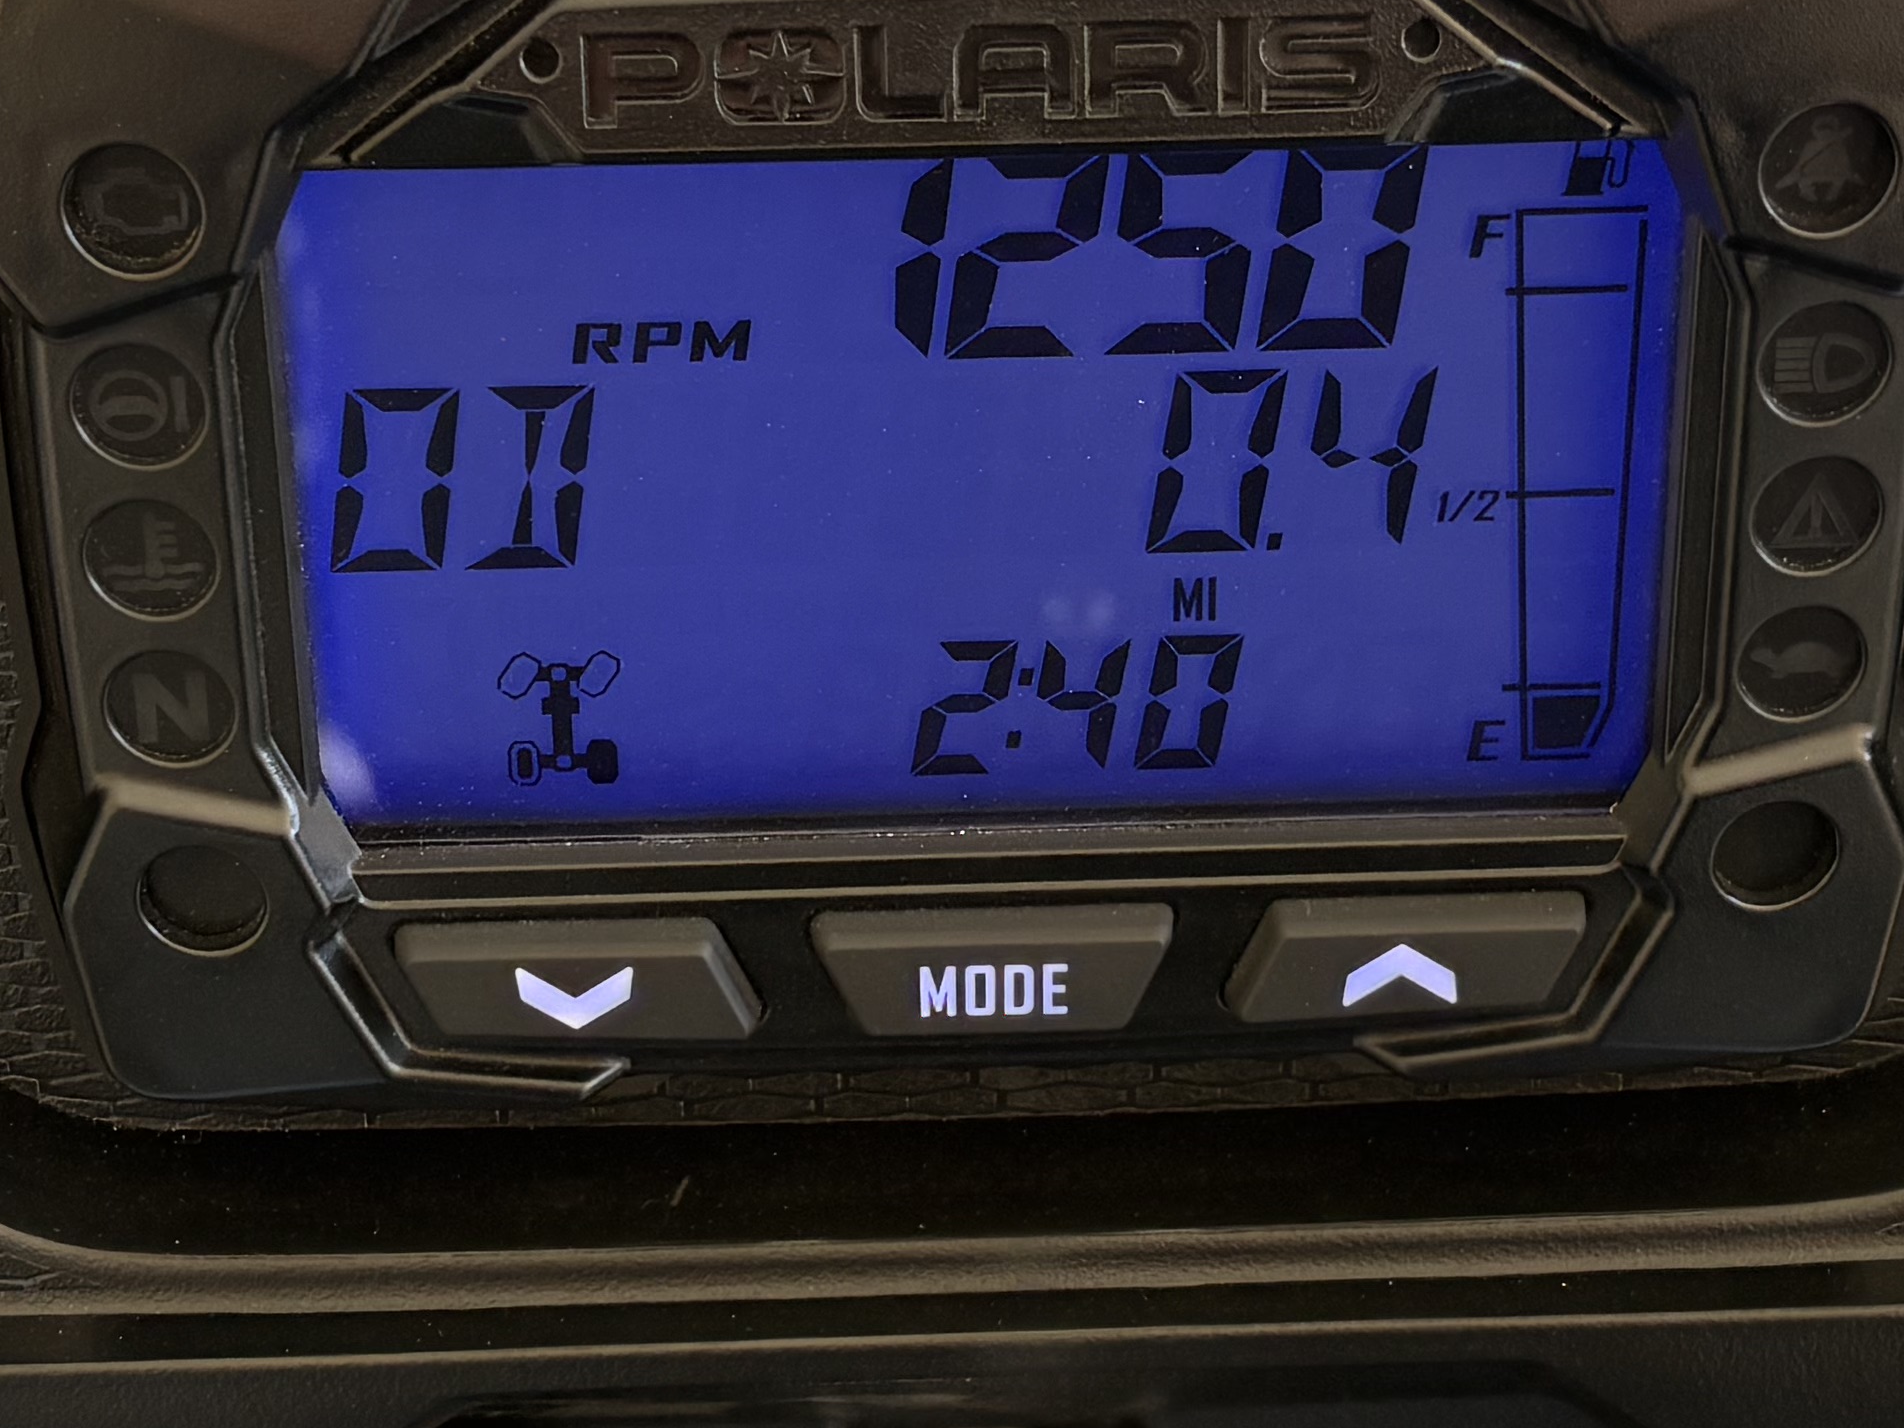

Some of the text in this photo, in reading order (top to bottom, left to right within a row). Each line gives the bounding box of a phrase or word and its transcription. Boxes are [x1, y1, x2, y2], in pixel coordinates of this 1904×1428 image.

[581, 12, 1379, 130] POLARIS
[895, 144, 1428, 359] 1250
[1469, 213, 1507, 259] F
[572, 318, 751, 365] RPM
[1145, 367, 1438, 553] 0.4
[1435, 489, 1499, 524] 1/2
[1171, 578, 1220, 623] MI
[133, 670, 212, 742] N
[911, 633, 1245, 777] 2:40
[1468, 720, 1504, 762] E
[917, 963, 1070, 1019] MODE
